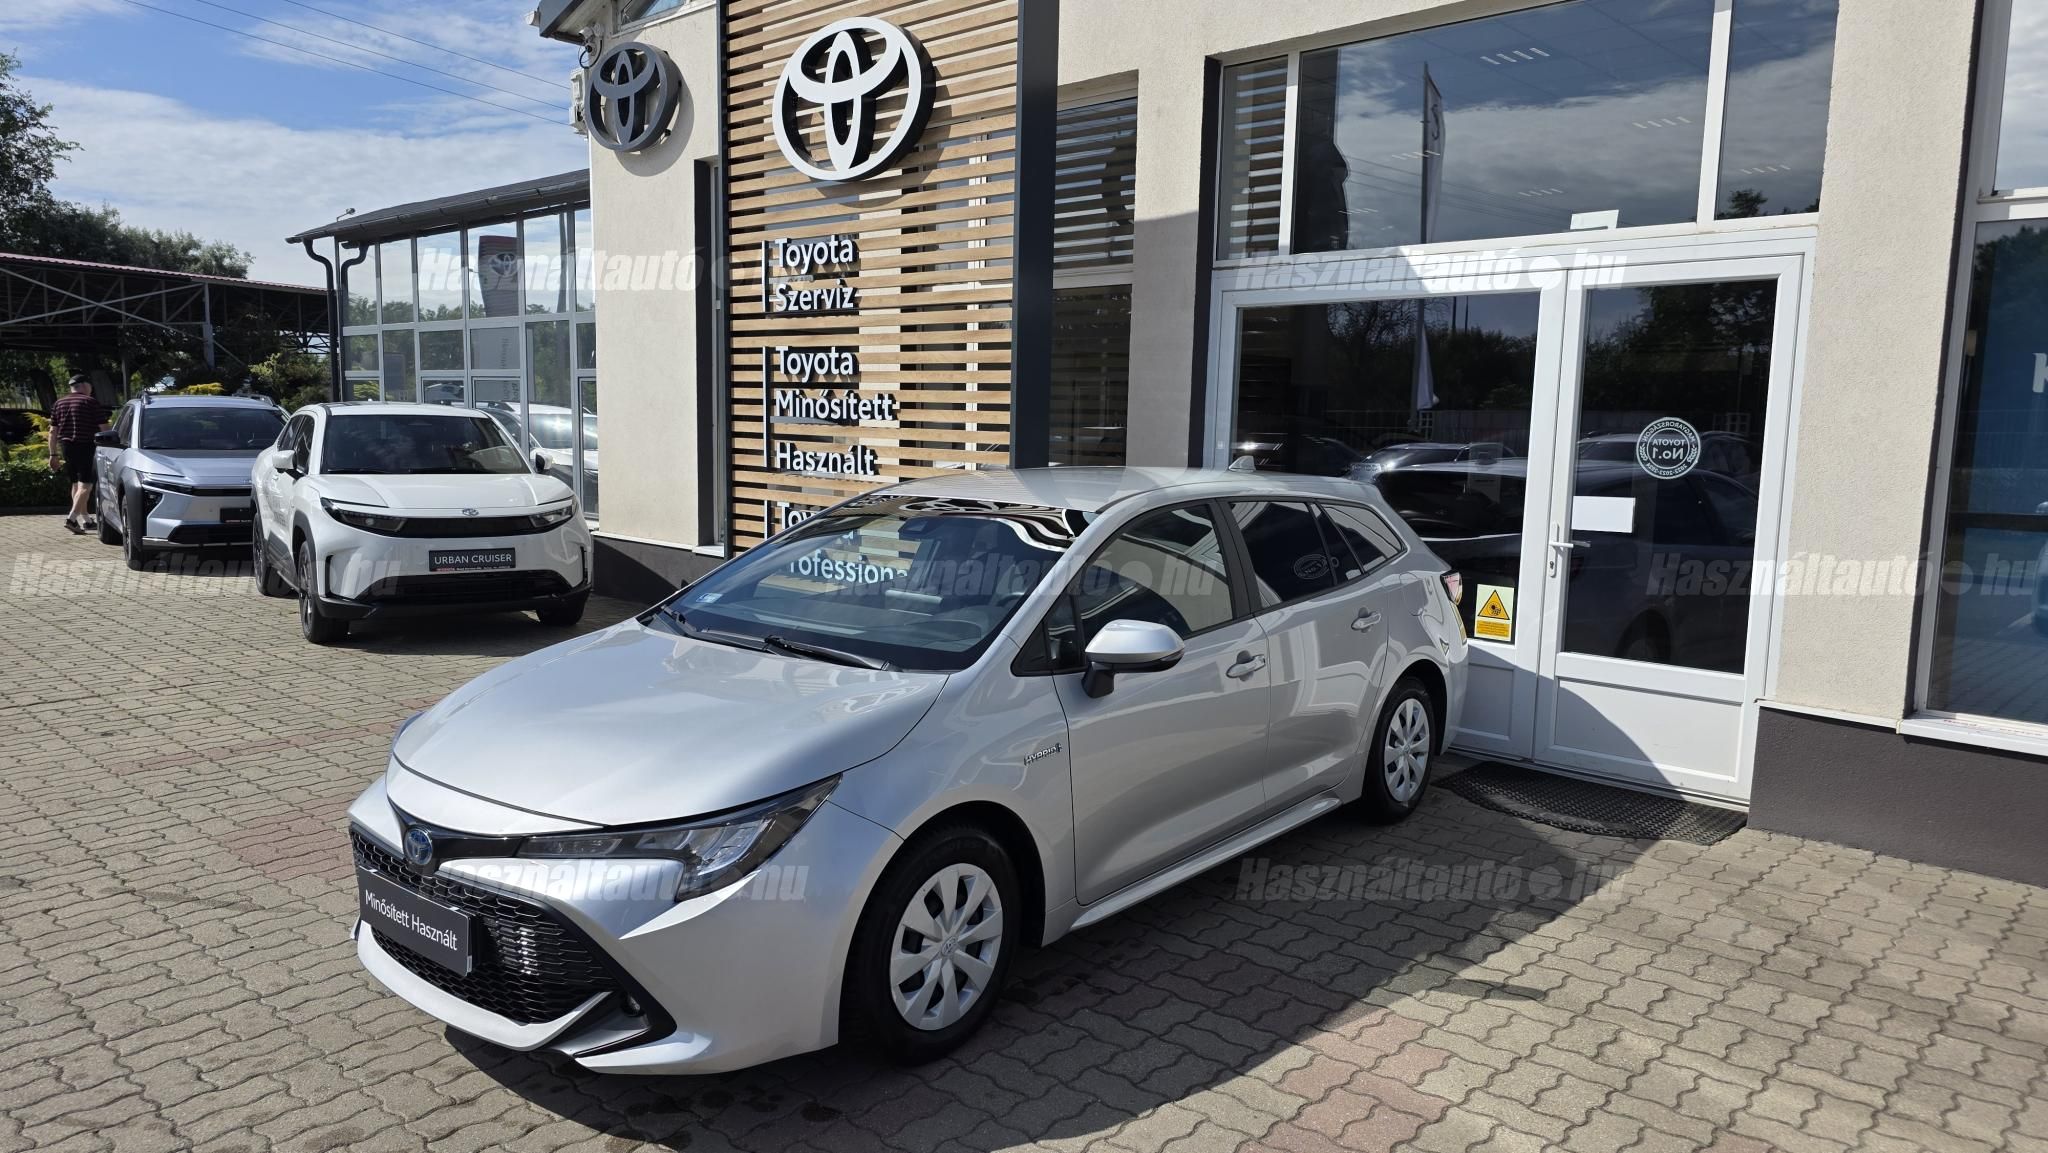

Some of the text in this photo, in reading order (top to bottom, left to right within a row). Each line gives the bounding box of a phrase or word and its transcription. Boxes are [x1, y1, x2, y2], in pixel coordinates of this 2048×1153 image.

[775, 235, 853, 274] Toyota
[775, 279, 853, 312] Szerviz
[776, 346, 853, 383] Toyota
[776, 389, 893, 420] Minősített
[776, 442, 875, 476] Használt
[434, 553, 512, 565] URBAN CRUISER
[365, 889, 458, 951] Minősített Használt
